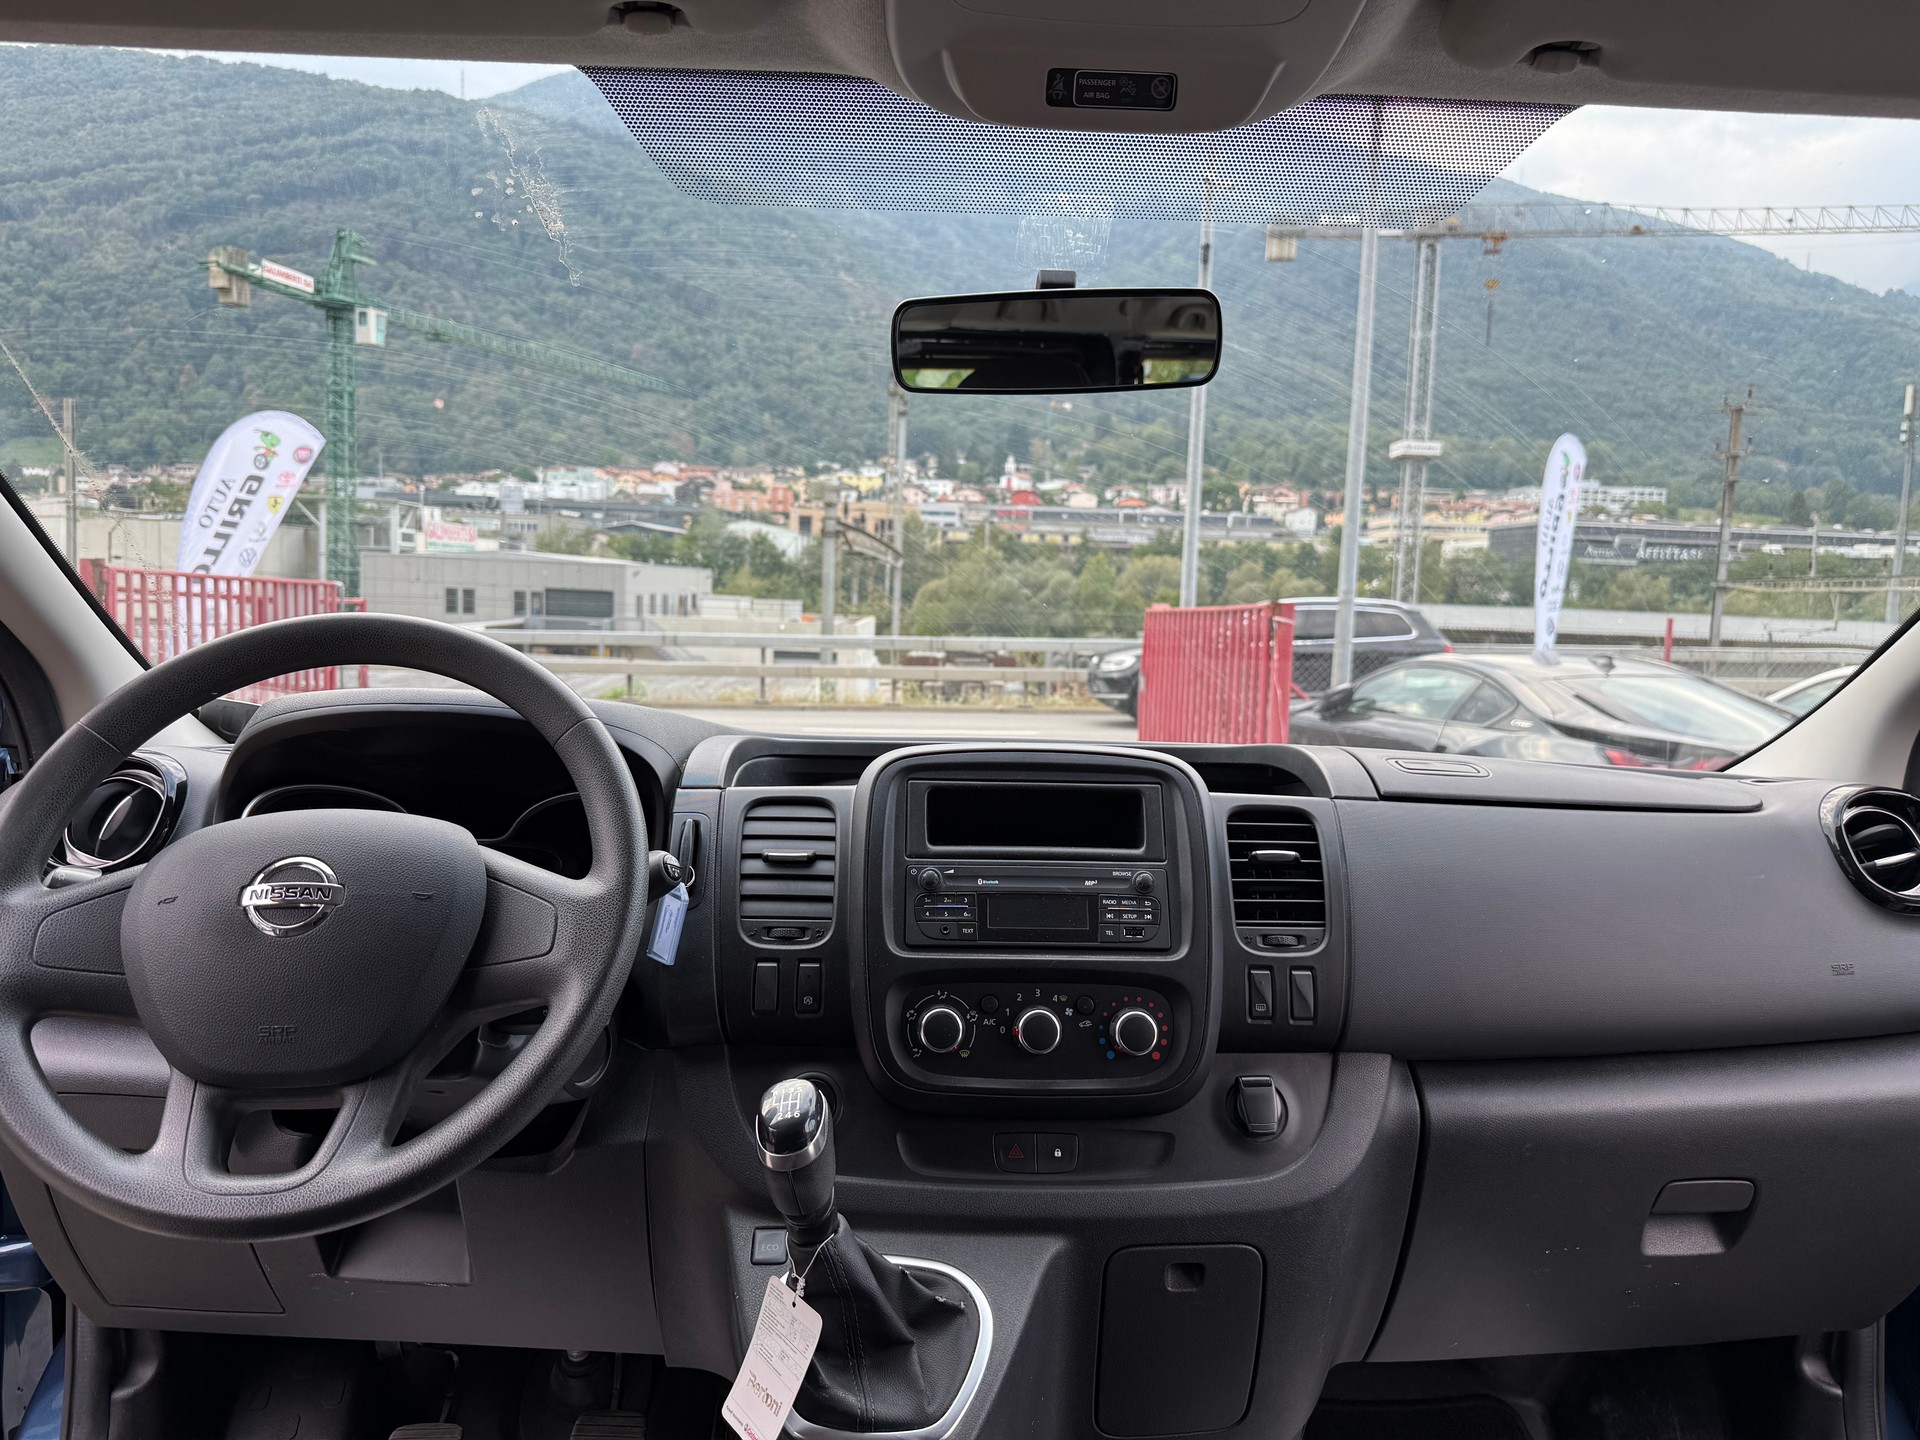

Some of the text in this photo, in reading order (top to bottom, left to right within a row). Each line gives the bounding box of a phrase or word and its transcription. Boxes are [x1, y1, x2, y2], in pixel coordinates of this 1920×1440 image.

[1078, 78, 1117, 86] PASSENGER
[1083, 91, 1110, 100] AIR BAG
[248, 886, 333, 901] NISSAN
[1035, 988, 1041, 997] 3
[1016, 993, 1022, 1002] 2
[1052, 994, 1058, 1003] 4
[1005, 1007, 1010, 1016] 1
[983, 1018, 996, 1026] A/C
[1000, 1025, 1006, 1034] 0
[793, 1110, 801, 1118] 6
[761, 1243, 779, 1252] ECO
